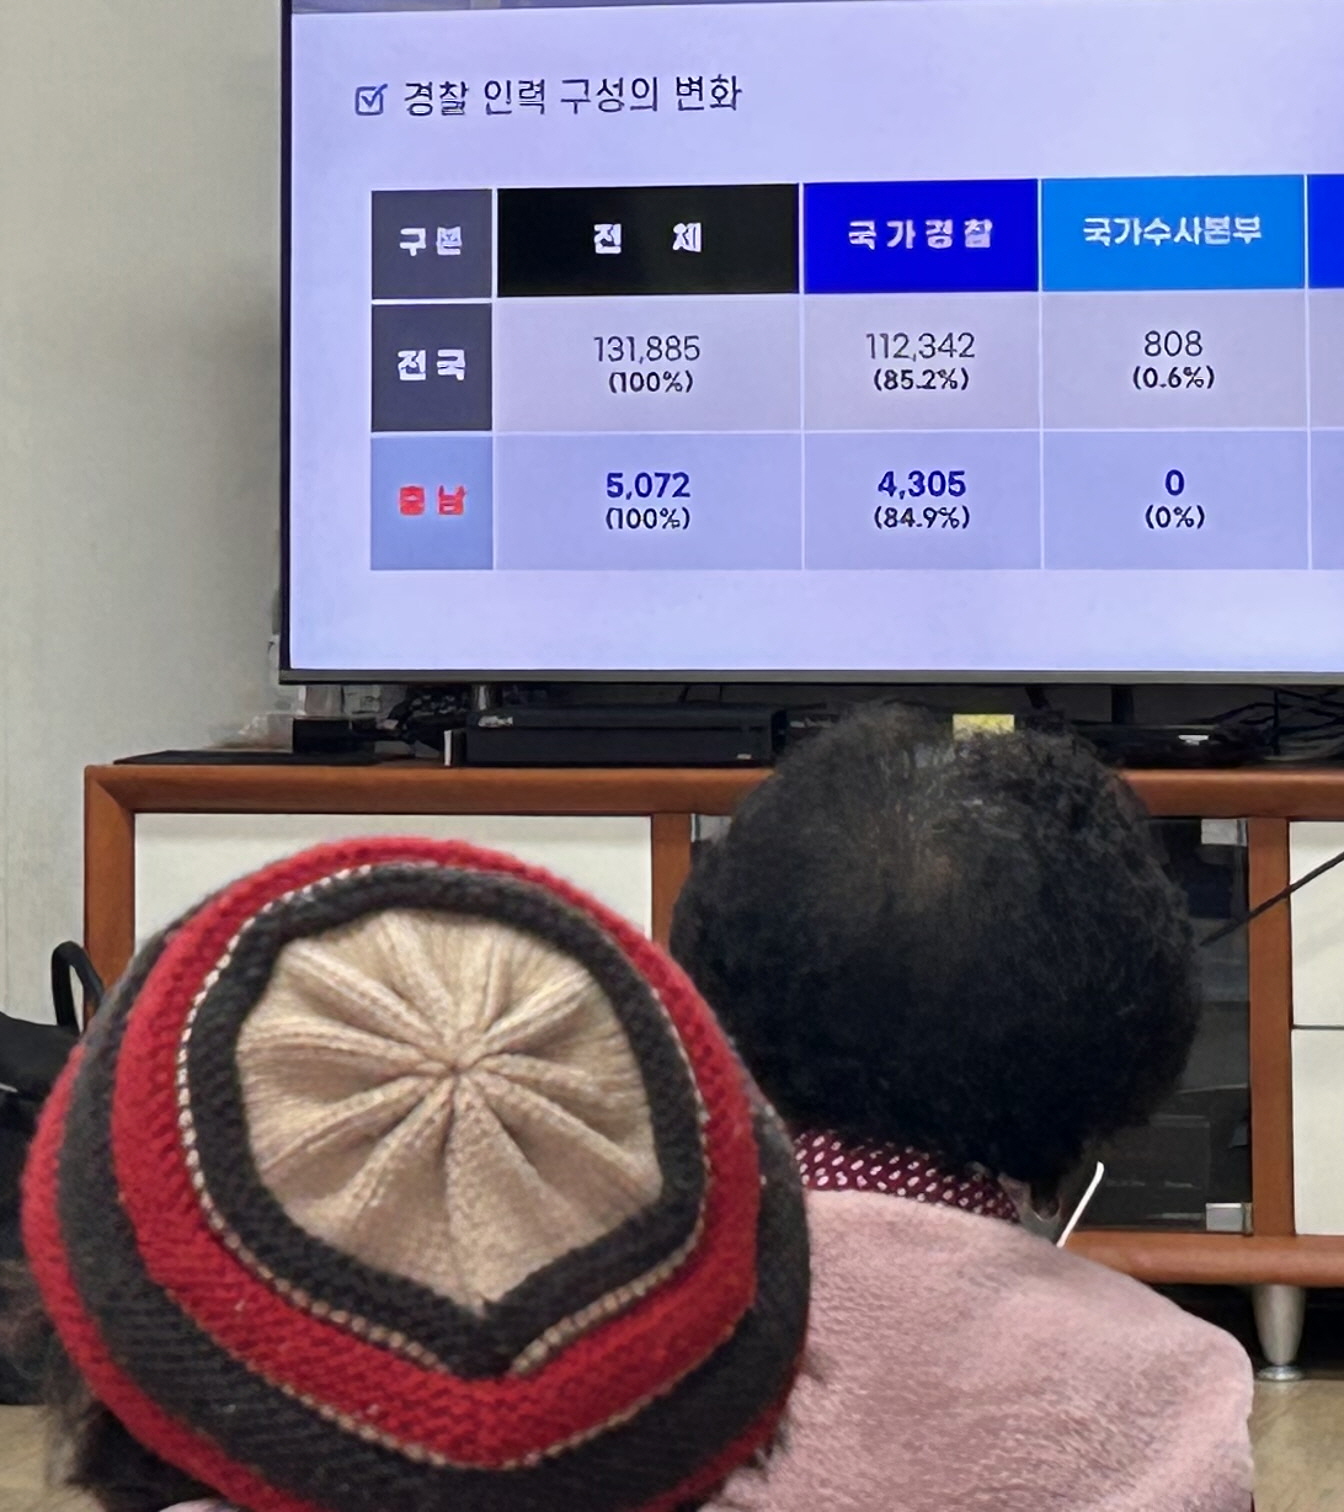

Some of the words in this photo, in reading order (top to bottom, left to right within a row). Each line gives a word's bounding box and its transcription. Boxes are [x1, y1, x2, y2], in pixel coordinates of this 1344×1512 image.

[402, 79, 470, 117] 경찰
[483, 76, 547, 116] 인력
[559, 75, 659, 115] 구성의
[674, 73, 743, 112] 변화
[1082, 215, 1263, 248] 국가수사본부
[593, 335, 702, 365] 131,885
[865, 331, 976, 363] 112,342
[1143, 329, 1204, 358] 808
[608, 369, 695, 395] (100%)
[873, 366, 970, 391] (85.2%)
[1132, 364, 1216, 390] (0.6%)
[606, 470, 692, 502] 5,072
[877, 469, 968, 500] 4,305
[1164, 468, 1186, 498] 0
[605, 505, 692, 532] (100%)
[873, 505, 972, 531] (84.9%)
[1144, 503, 1207, 532] (0%)
